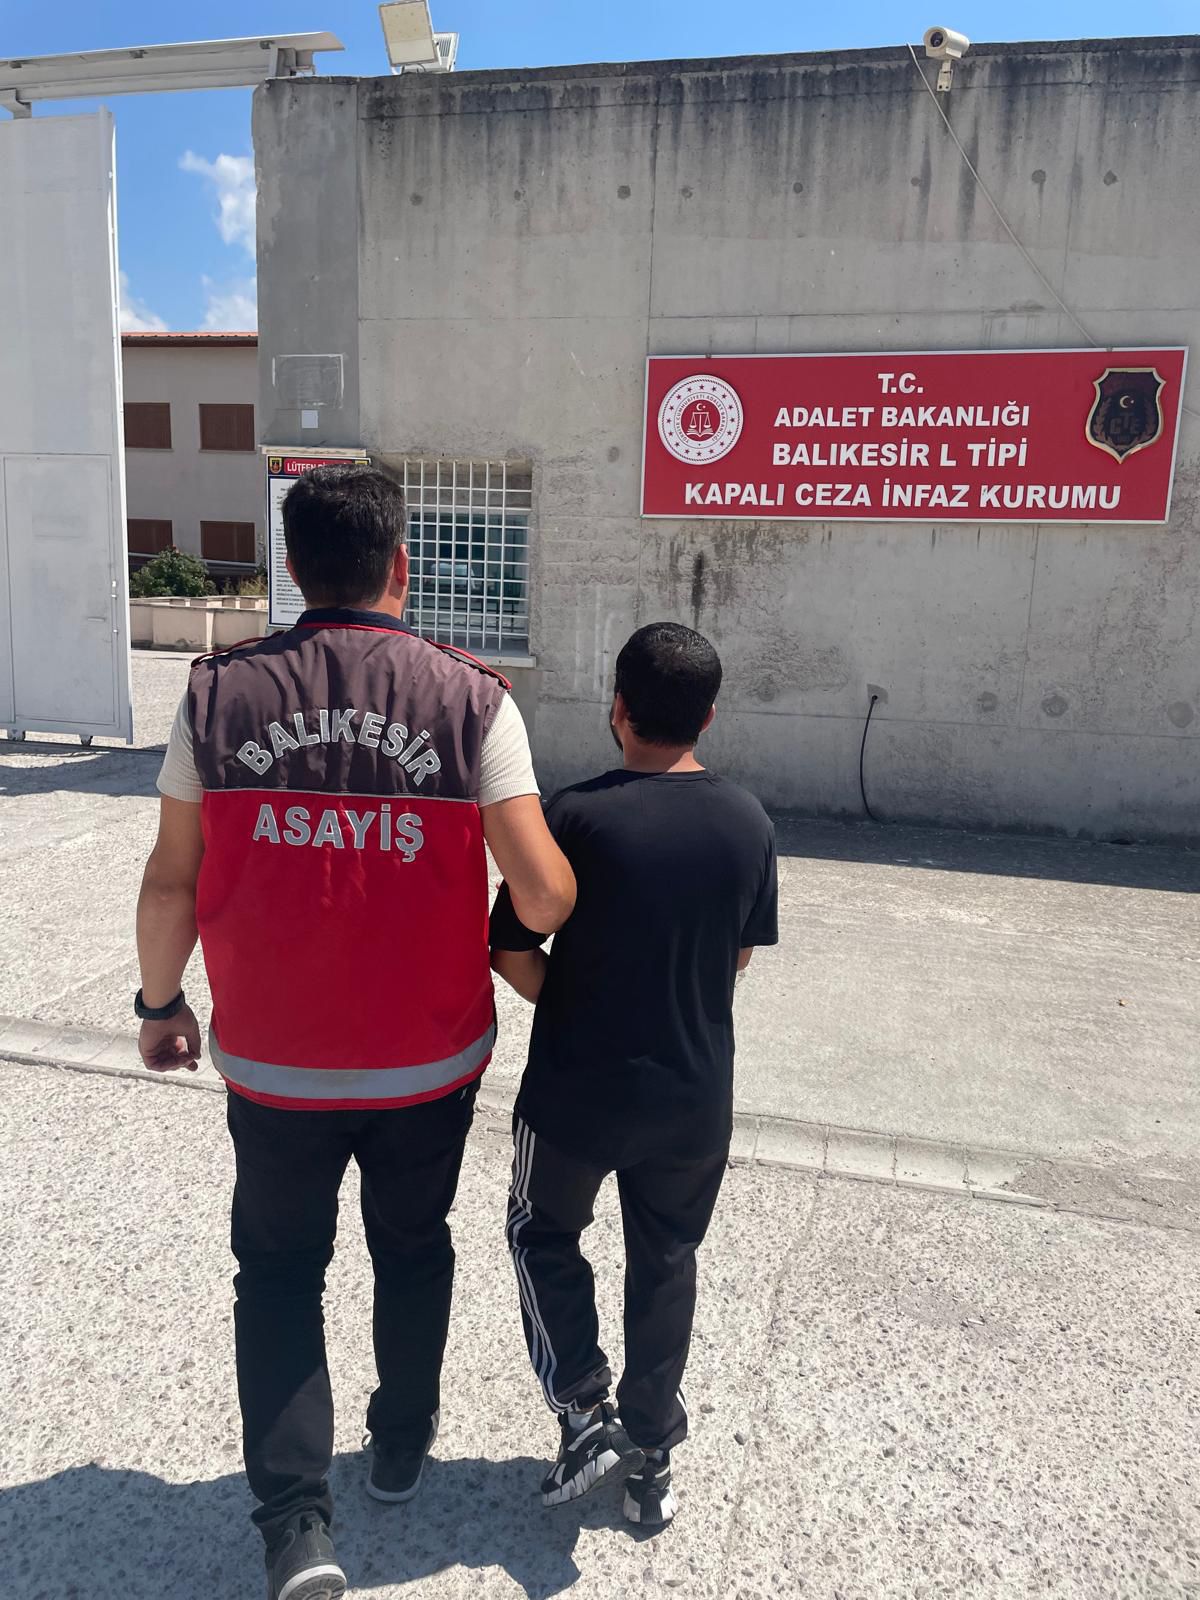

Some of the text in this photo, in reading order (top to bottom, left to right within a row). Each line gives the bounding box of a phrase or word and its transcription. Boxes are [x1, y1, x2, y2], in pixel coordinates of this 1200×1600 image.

[877, 372, 924, 394] T.C.
[773, 400, 1030, 427] ADALET BAKANLIĞI
[1109, 411, 1141, 435] CTE
[772, 437, 1028, 467] BALIKESİR L TİPİ
[685, 478, 1121, 509] KAPALI CEZA İNFAZ KURUMU
[235, 708, 442, 787] BALIKESİR
[252, 803, 425, 863] ASAYİŞ
